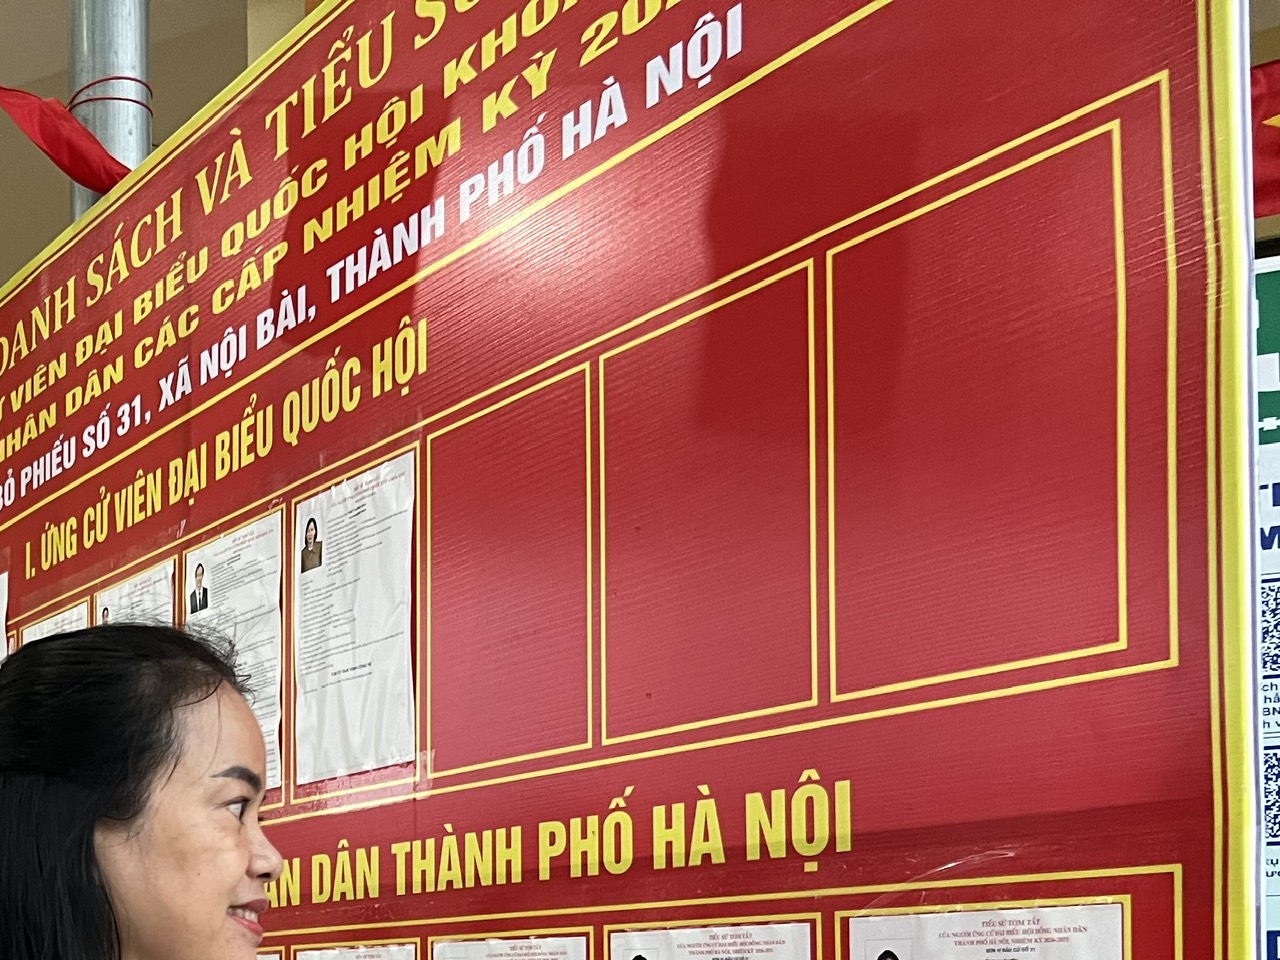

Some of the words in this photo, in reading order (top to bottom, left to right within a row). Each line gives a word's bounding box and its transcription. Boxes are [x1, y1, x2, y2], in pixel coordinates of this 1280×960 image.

[10, 352, 67, 412] VIÊN
[75, 310, 123, 366] ĐẠI
[132, 246, 208, 325] BIỂU
[220, 157, 328, 259] QUỐC
[344, 83, 424, 172] HỘI
[20, 433, 76, 498] PHIẾU
[82, 402, 111, 458] SỐ
[117, 393, 152, 438] 31,
[158, 356, 192, 411] XÃ
[200, 324, 247, 386] NỘI
[256, 284, 317, 351] BÀI,
[326, 195, 446, 304] THÀNH
[458, 111, 548, 225] PHỐ
[561, 75, 628, 161] HÀ
[645, 3, 743, 110] NỘI
[65, 355, 124, 418] DÂN
[134, 304, 200, 369] CÁC
[211, 240, 289, 315] CẤP
[303, 116, 462, 254] NHIỆM
[482, 47, 558, 134] KỲ
[86, 188, 184, 307] SÁCH
[195, 127, 252, 216] VÀ
[265, 10, 396, 162] TIỂU
[414, 0, 482, 50] S
[40, 515, 78, 572] ỨNG
[82, 485, 111, 550] CỬ
[114, 467, 163, 533] VIÊN
[168, 441, 207, 506] ĐẠI
[214, 392, 274, 481] BIỂU
[282, 346, 362, 447] QUỐC
[371, 314, 429, 398] HỘI
[311, 839, 379, 904] DÂN
[391, 823, 522, 896] THÀNH
[538, 785, 635, 881] PHỐ
[652, 784, 727, 870] HÀ
[744, 768, 853, 873] NỘI
